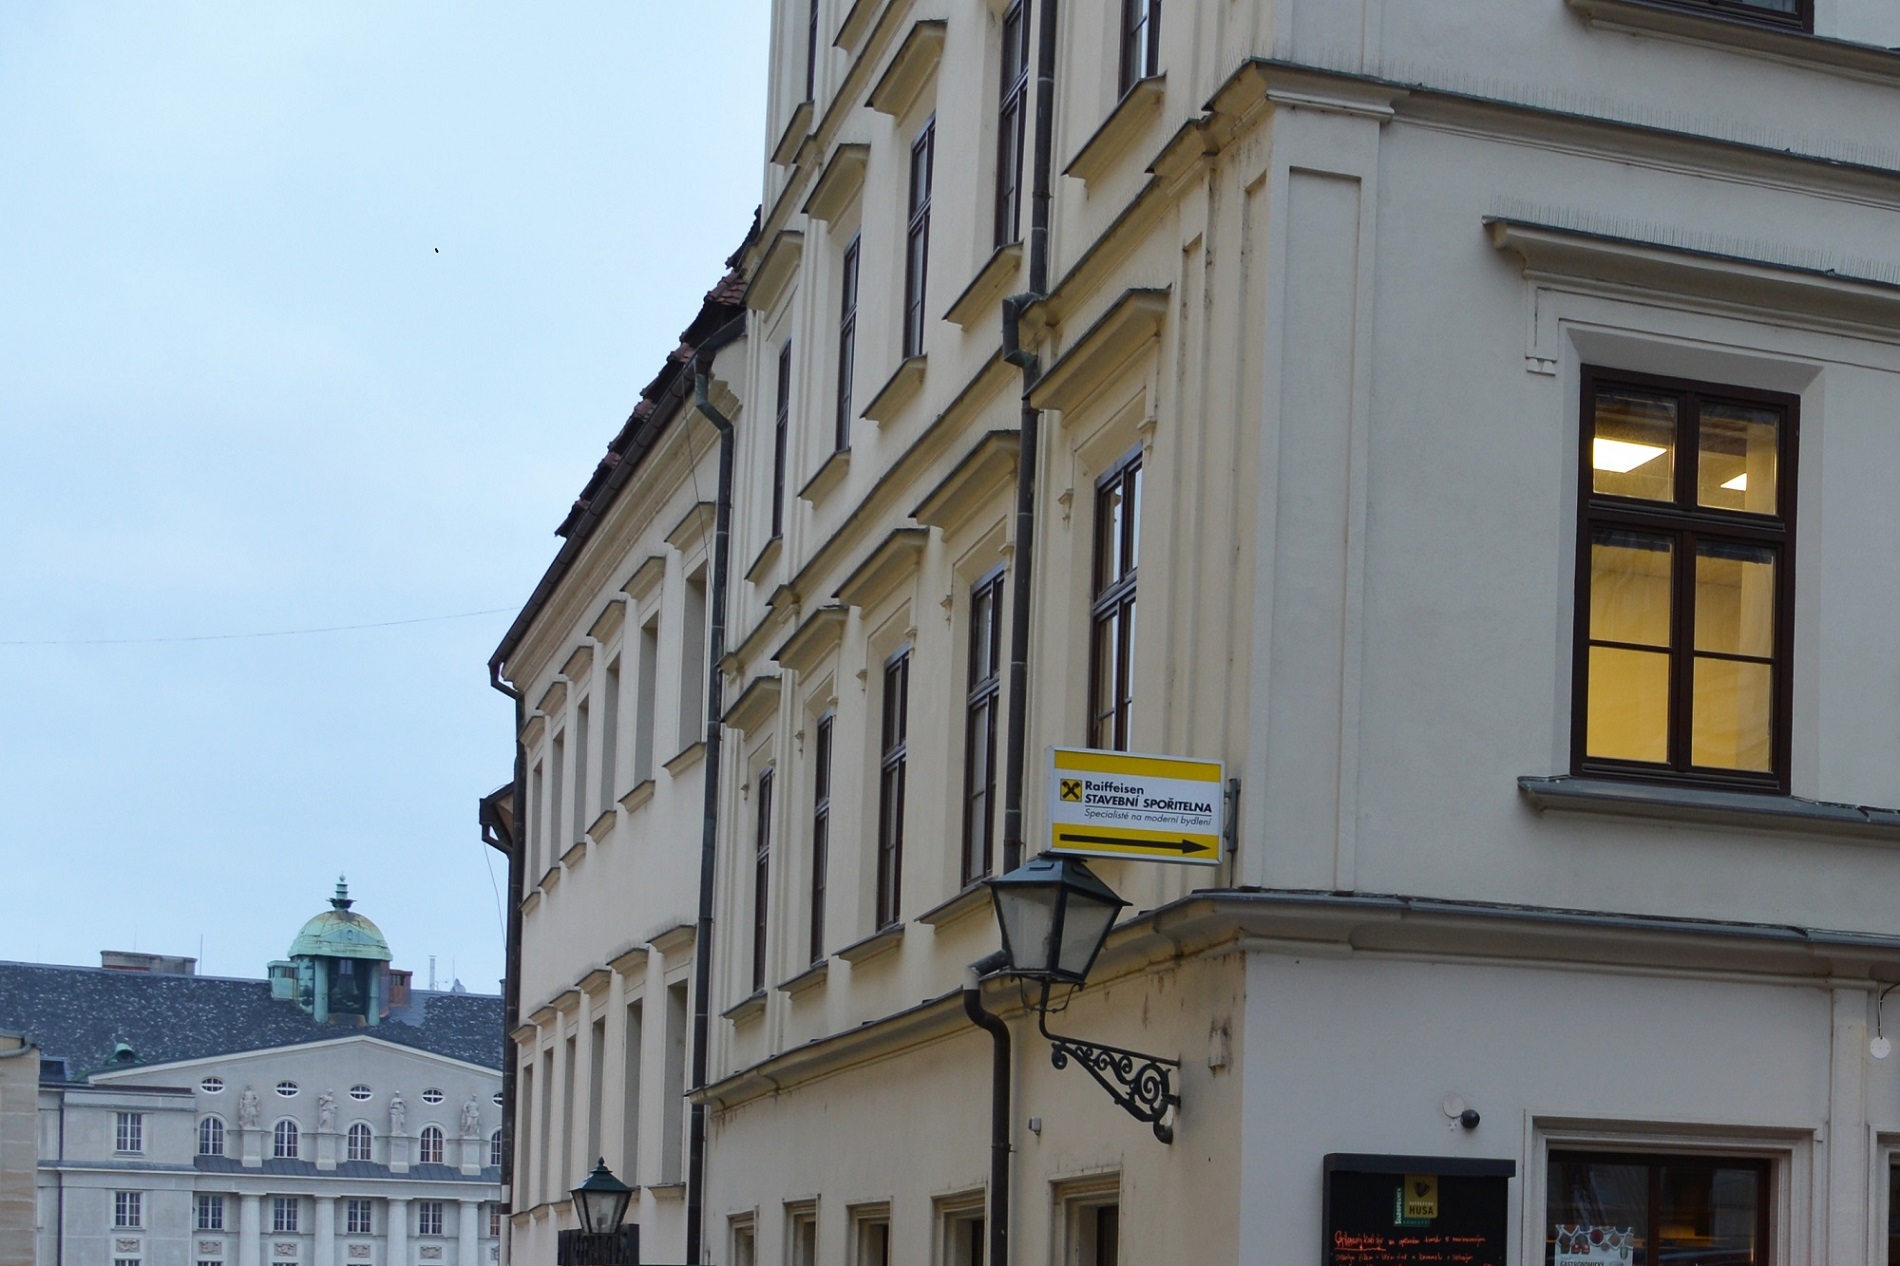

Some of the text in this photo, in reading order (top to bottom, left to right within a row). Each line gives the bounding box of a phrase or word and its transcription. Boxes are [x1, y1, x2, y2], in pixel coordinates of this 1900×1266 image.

[1084, 780, 1144, 795] Raiffeisen
[1084, 794, 1212, 813] STAVEBNÍ SPOŘITELNA
[1084, 808, 1129, 820] Specialisté
[1144, 814, 1178, 824] moderní
[1181, 816, 1212, 826] bydlení
[1408, 1206, 1434, 1216] HUSA
